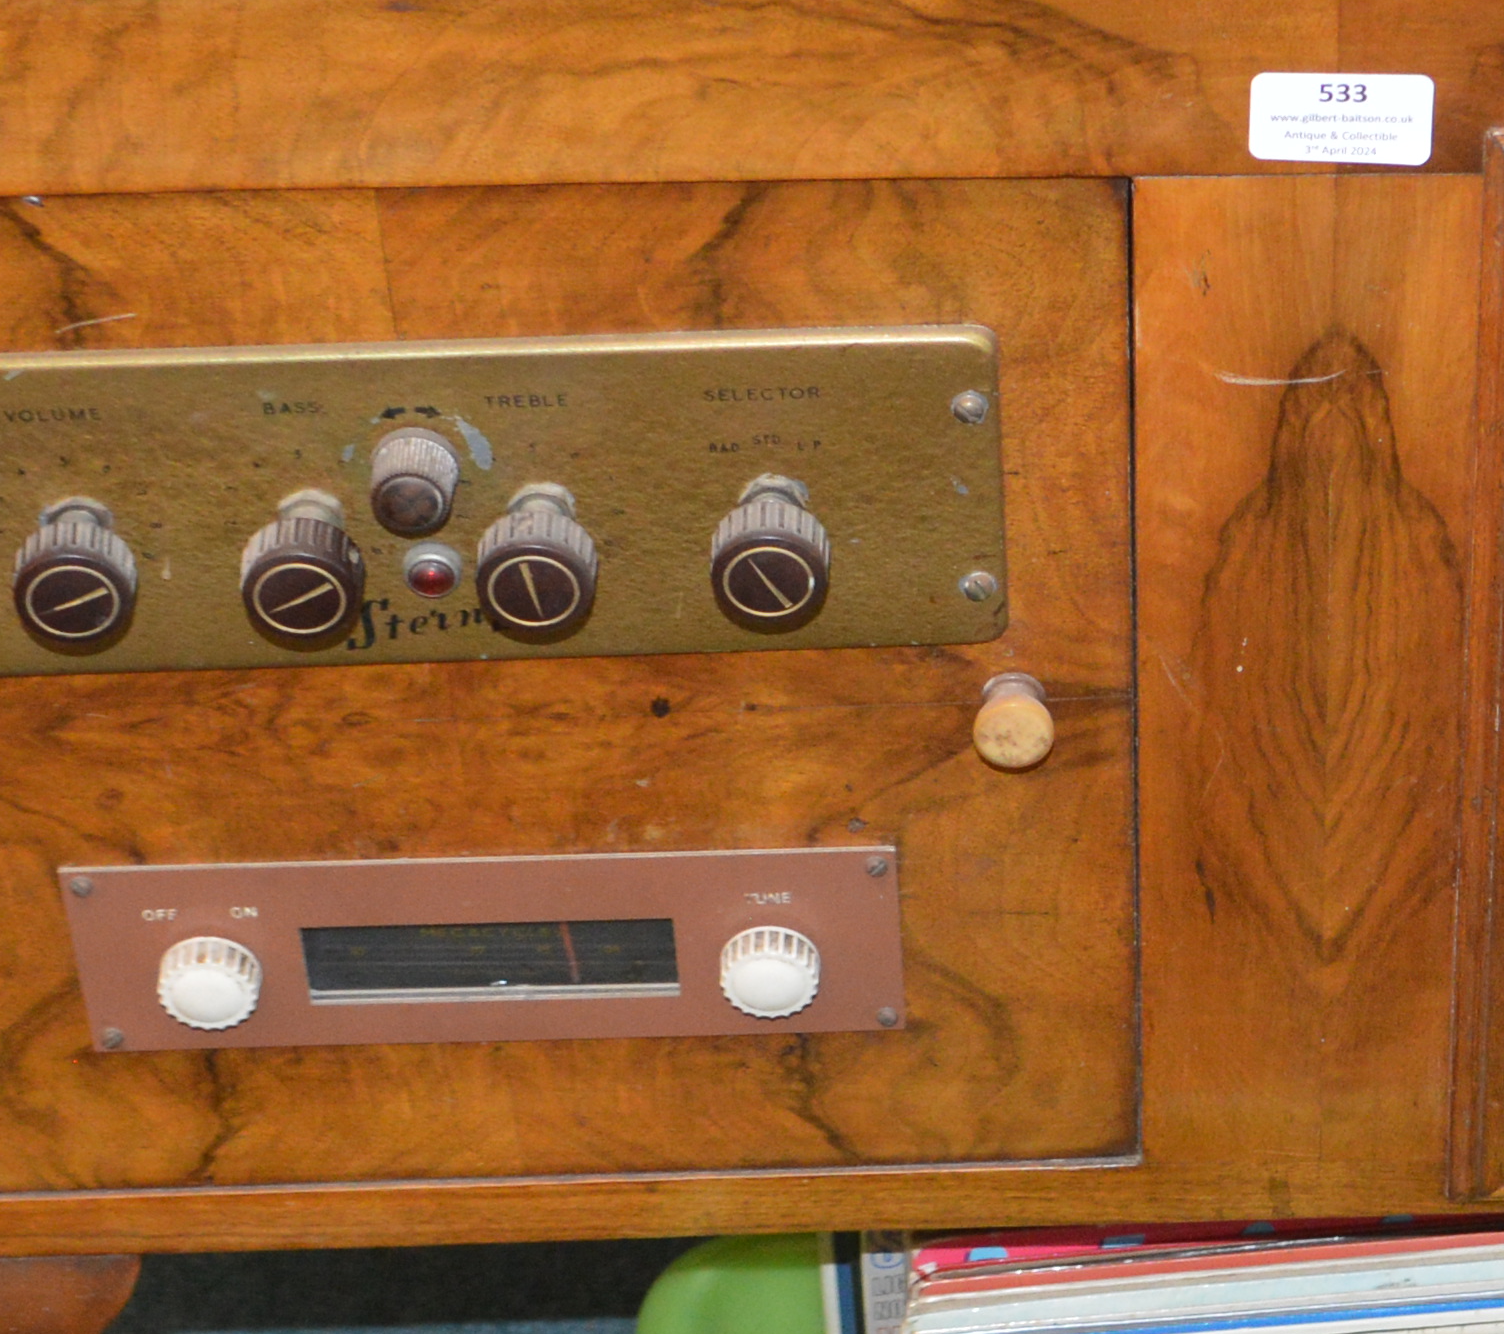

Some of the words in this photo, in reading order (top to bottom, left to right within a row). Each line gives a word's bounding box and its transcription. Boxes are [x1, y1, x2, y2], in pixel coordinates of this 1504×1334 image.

[1318, 83, 1368, 103] 533
[1270, 113, 1414, 125] www.gilbert-baitson.co.uk
[1284, 130, 1327, 141] Antique
[1330, 131, 1339, 141] &
[1342, 131, 1398, 141] Collectible
[1322, 145, 1347, 156] April
[1350, 146, 1377, 156] 2024
[484, 393, 570, 408] TREBLE
[702, 386, 822, 403] SELECTOR
[3, 406, 102, 423] VOLUME
[261, 400, 320, 416] BASS
[743, 891, 793, 905] TUNE
[141, 908, 178, 921] OFF
[229, 906, 259, 919] ON
